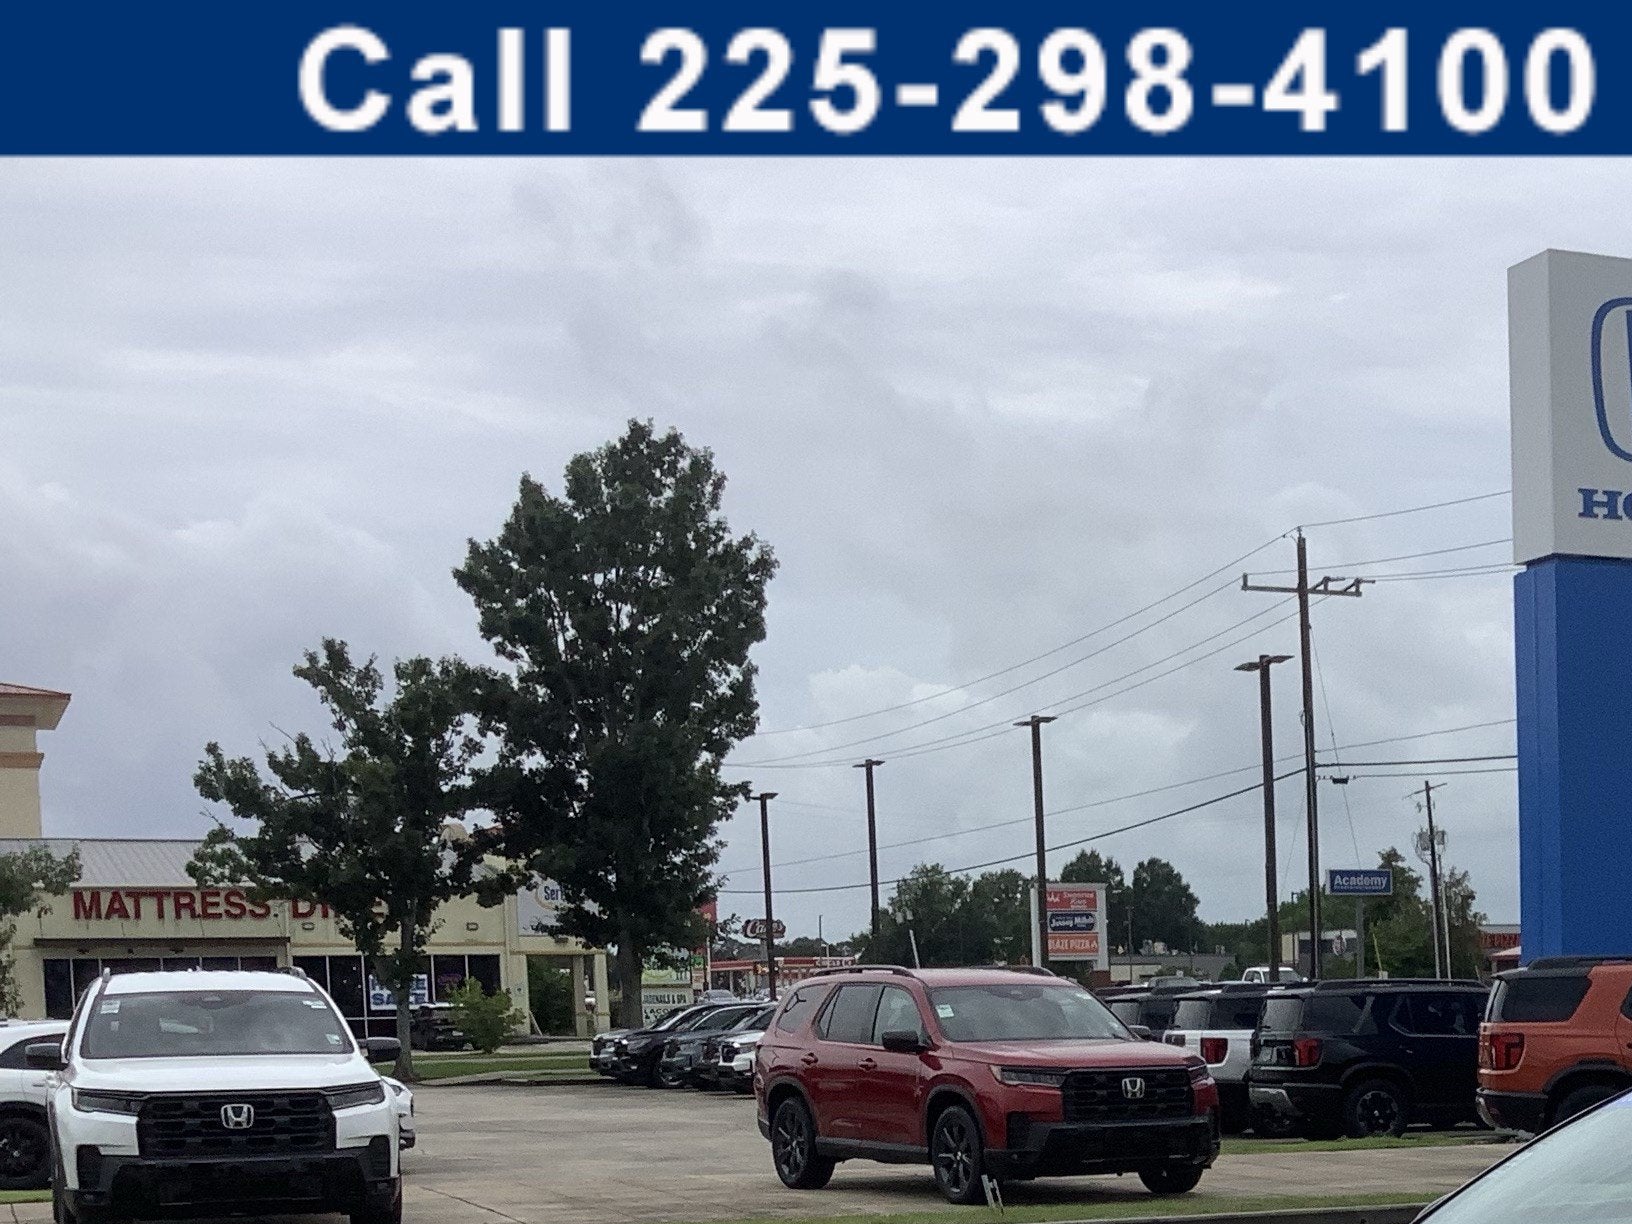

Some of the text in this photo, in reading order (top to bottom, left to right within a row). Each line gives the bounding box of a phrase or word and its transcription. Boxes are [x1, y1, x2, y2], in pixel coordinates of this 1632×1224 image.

[1333, 874, 1388, 889] Academy
[73, 888, 271, 920] MATTRESS
[371, 992, 426, 1005] SAE
